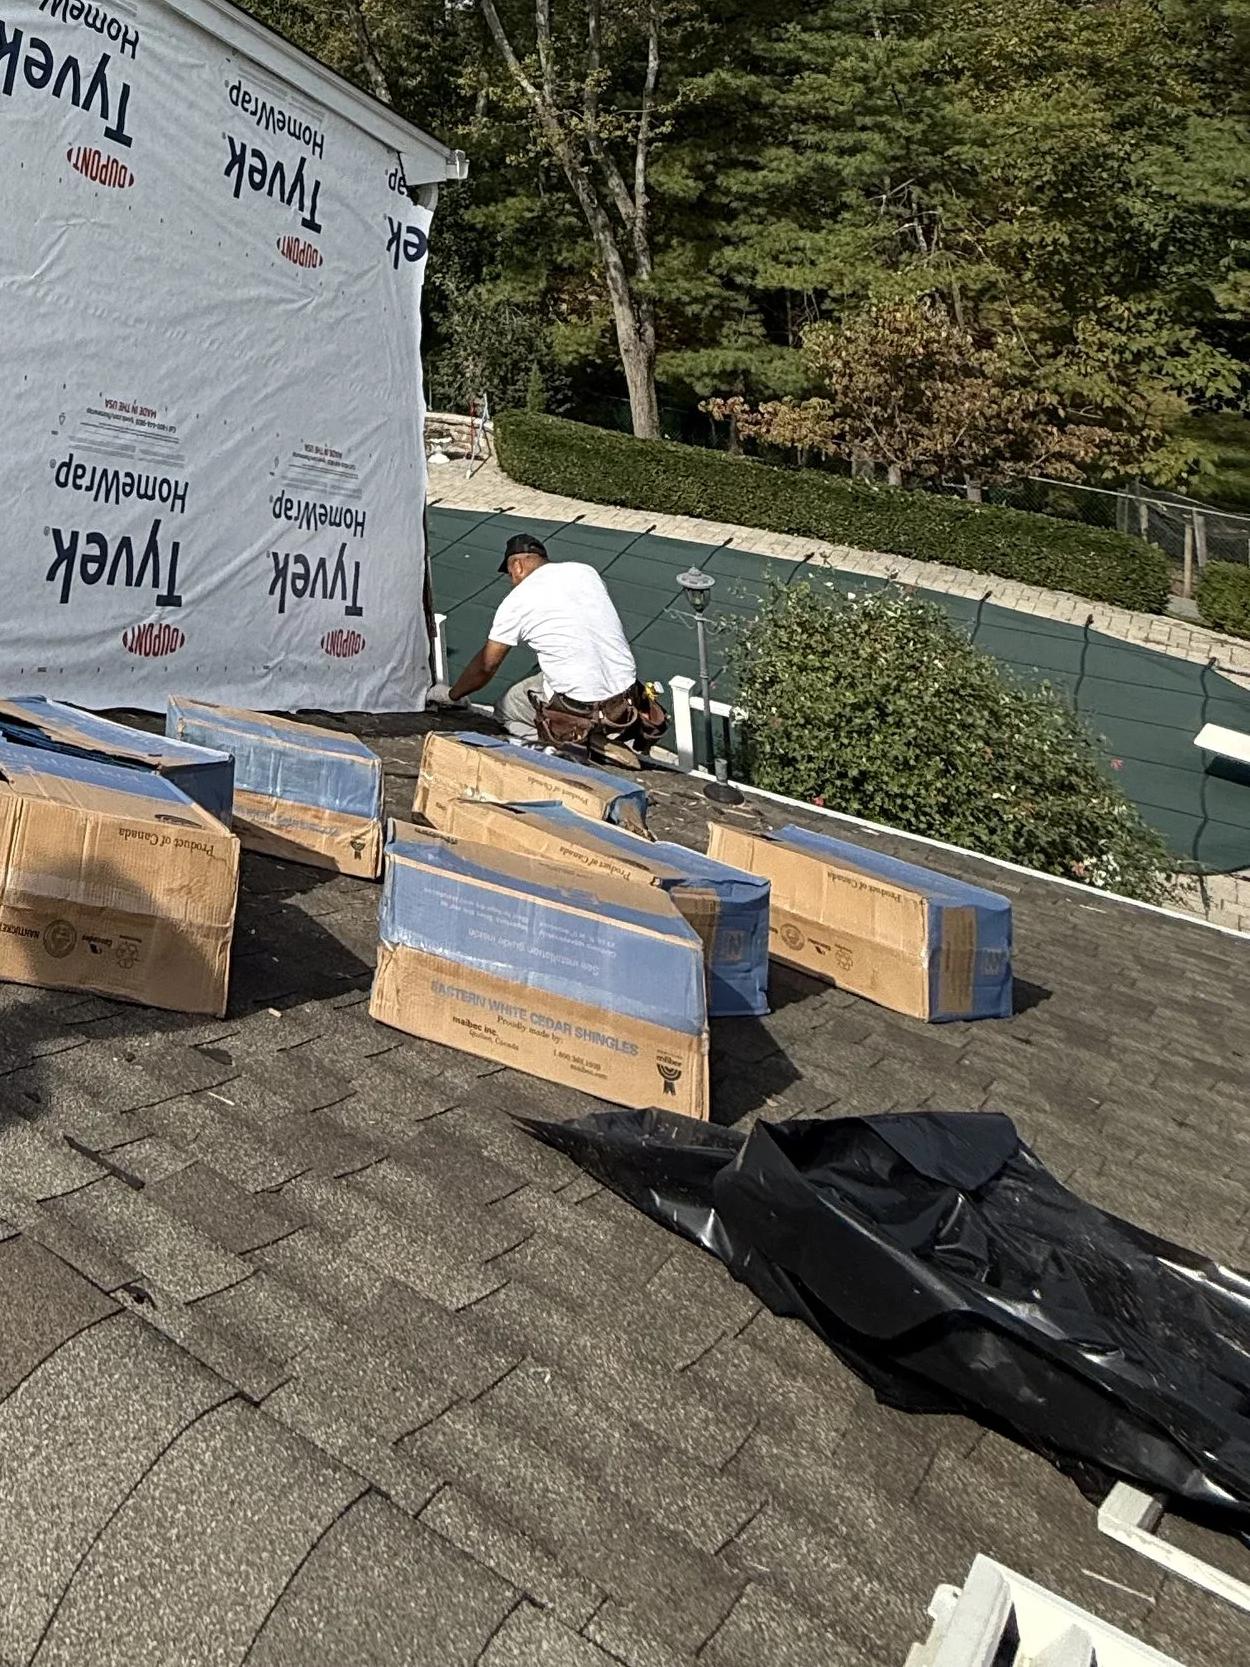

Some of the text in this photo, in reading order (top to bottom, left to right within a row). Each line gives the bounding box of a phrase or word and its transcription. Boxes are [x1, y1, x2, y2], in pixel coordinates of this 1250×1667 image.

[229, 79, 325, 160] HomeWrap
[72, 146, 129, 189] DUPONT
[223, 134, 323, 235] Tyvek
[280, 235, 320, 269] DUPONT
[55, 452, 190, 514] HomeWrap
[272, 489, 367, 539] HomeWrap
[45, 518, 183, 608] Tyvek
[268, 542, 364, 617] Tyvek
[127, 622, 180, 658] DUPONT
[118, 827, 215, 858] Product of Canada
[559, 845, 589, 864] Canada
[598, 859, 632, 881] Product
[827, 871, 858, 889] Canada
[868, 885, 902, 903] Product
[430, 979, 488, 1008] EASTERN
[487, 998, 528, 1021] WHITE
[529, 1011, 573, 1036] CEDAR
[574, 1026, 640, 1057] SHINGLES
[452, 1014, 483, 1032] maibec
[497, 1015, 527, 1033] Proudly
